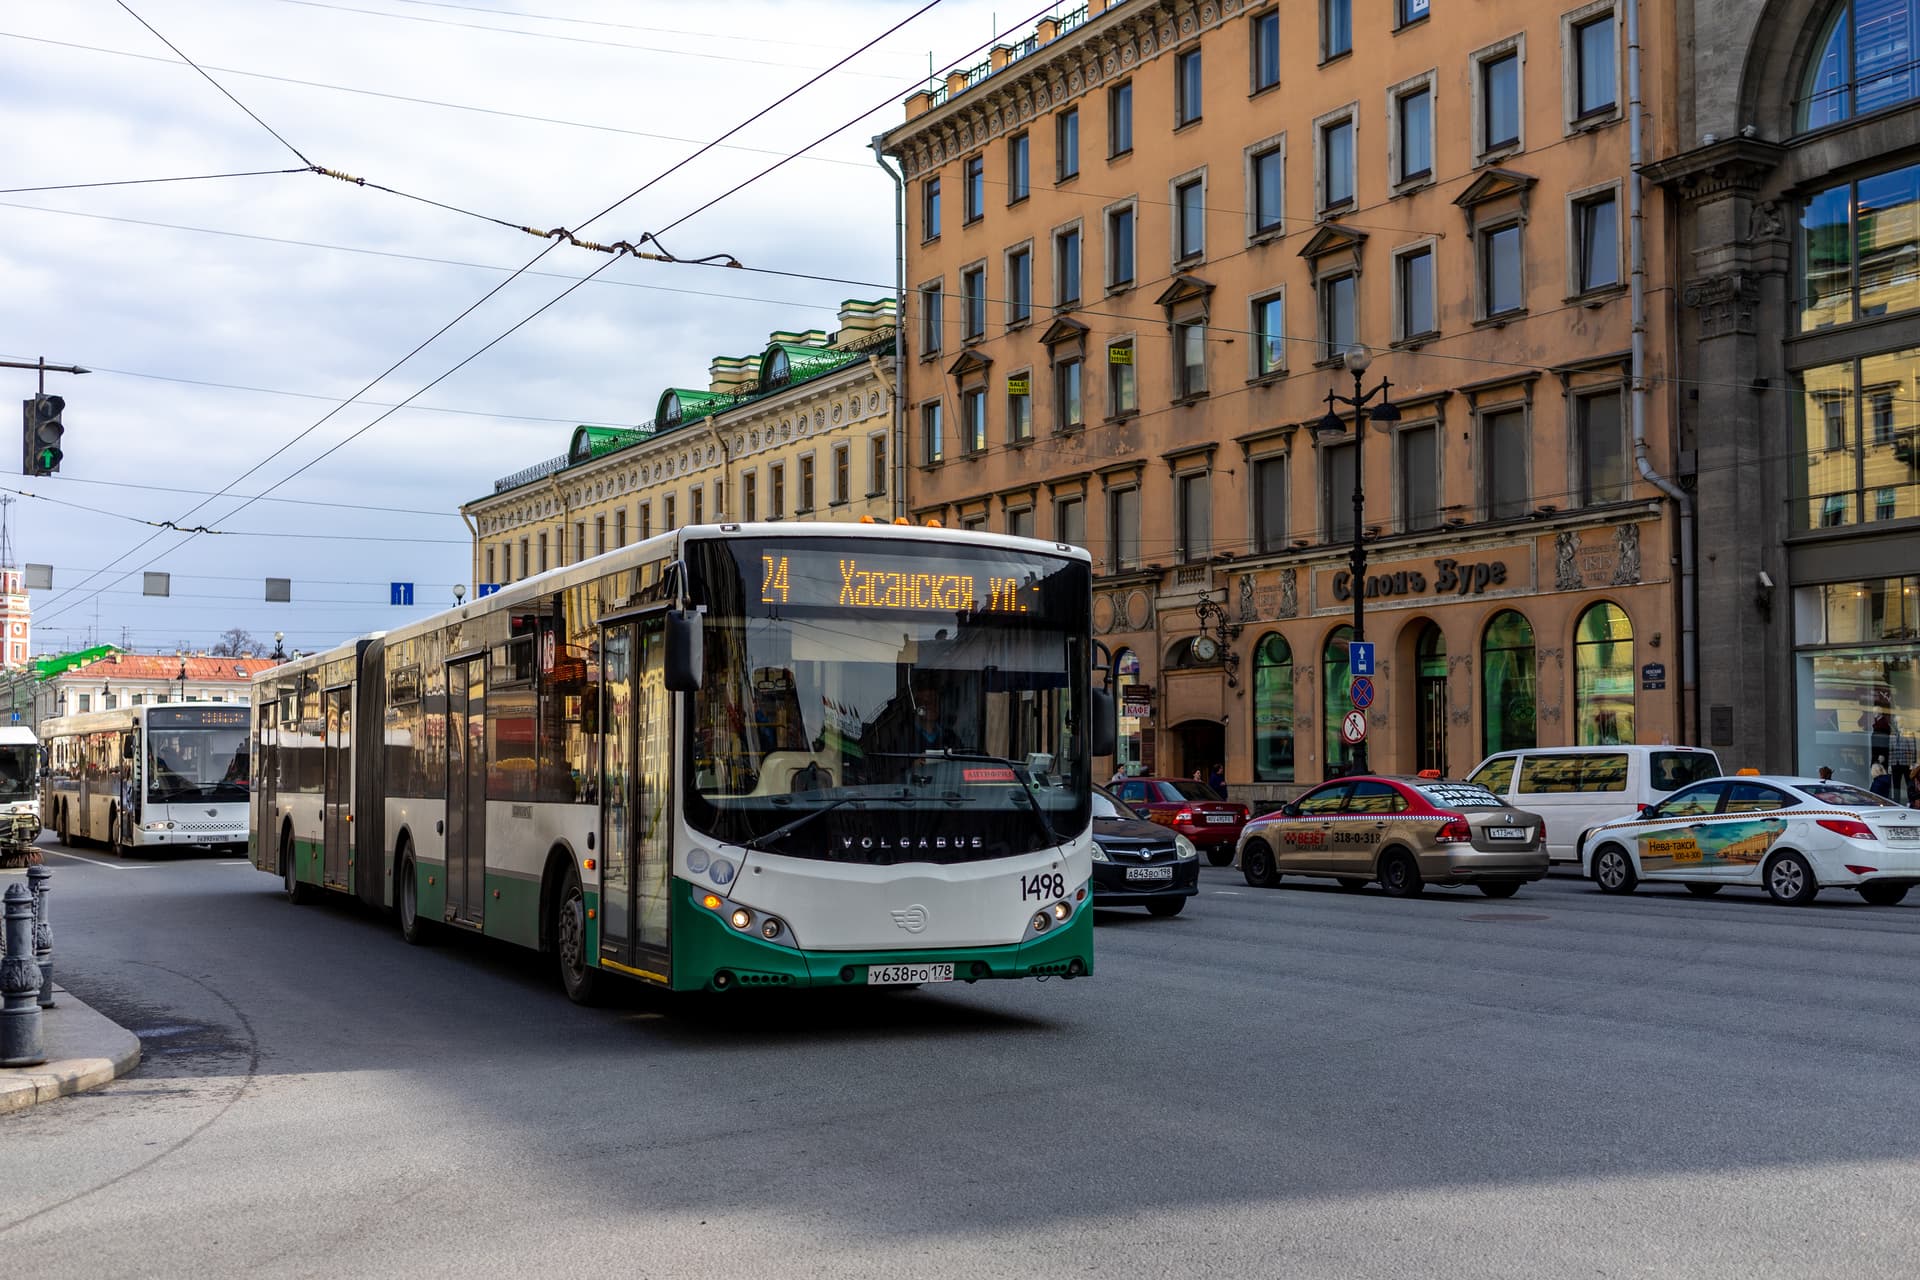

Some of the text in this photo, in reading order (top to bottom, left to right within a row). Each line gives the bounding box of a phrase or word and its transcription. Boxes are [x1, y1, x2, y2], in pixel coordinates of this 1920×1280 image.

[761, 556, 789, 602] 24
[839, 560, 973, 610] Хасанская
[989, 577, 1027, 612] ул.
[1333, 558, 1506, 601] Слонъ Буре
[1127, 706, 1149, 714] КАФЕ
[842, 837, 983, 848] VOLGABUS
[1297, 829, 1326, 845] ВЕЗЁТ
[1334, 832, 1381, 844] 318-0-318
[1649, 841, 1696, 852] Нева-такси
[1020, 873, 1065, 901] 1498
[873, 965, 951, 983] У638РО 178
